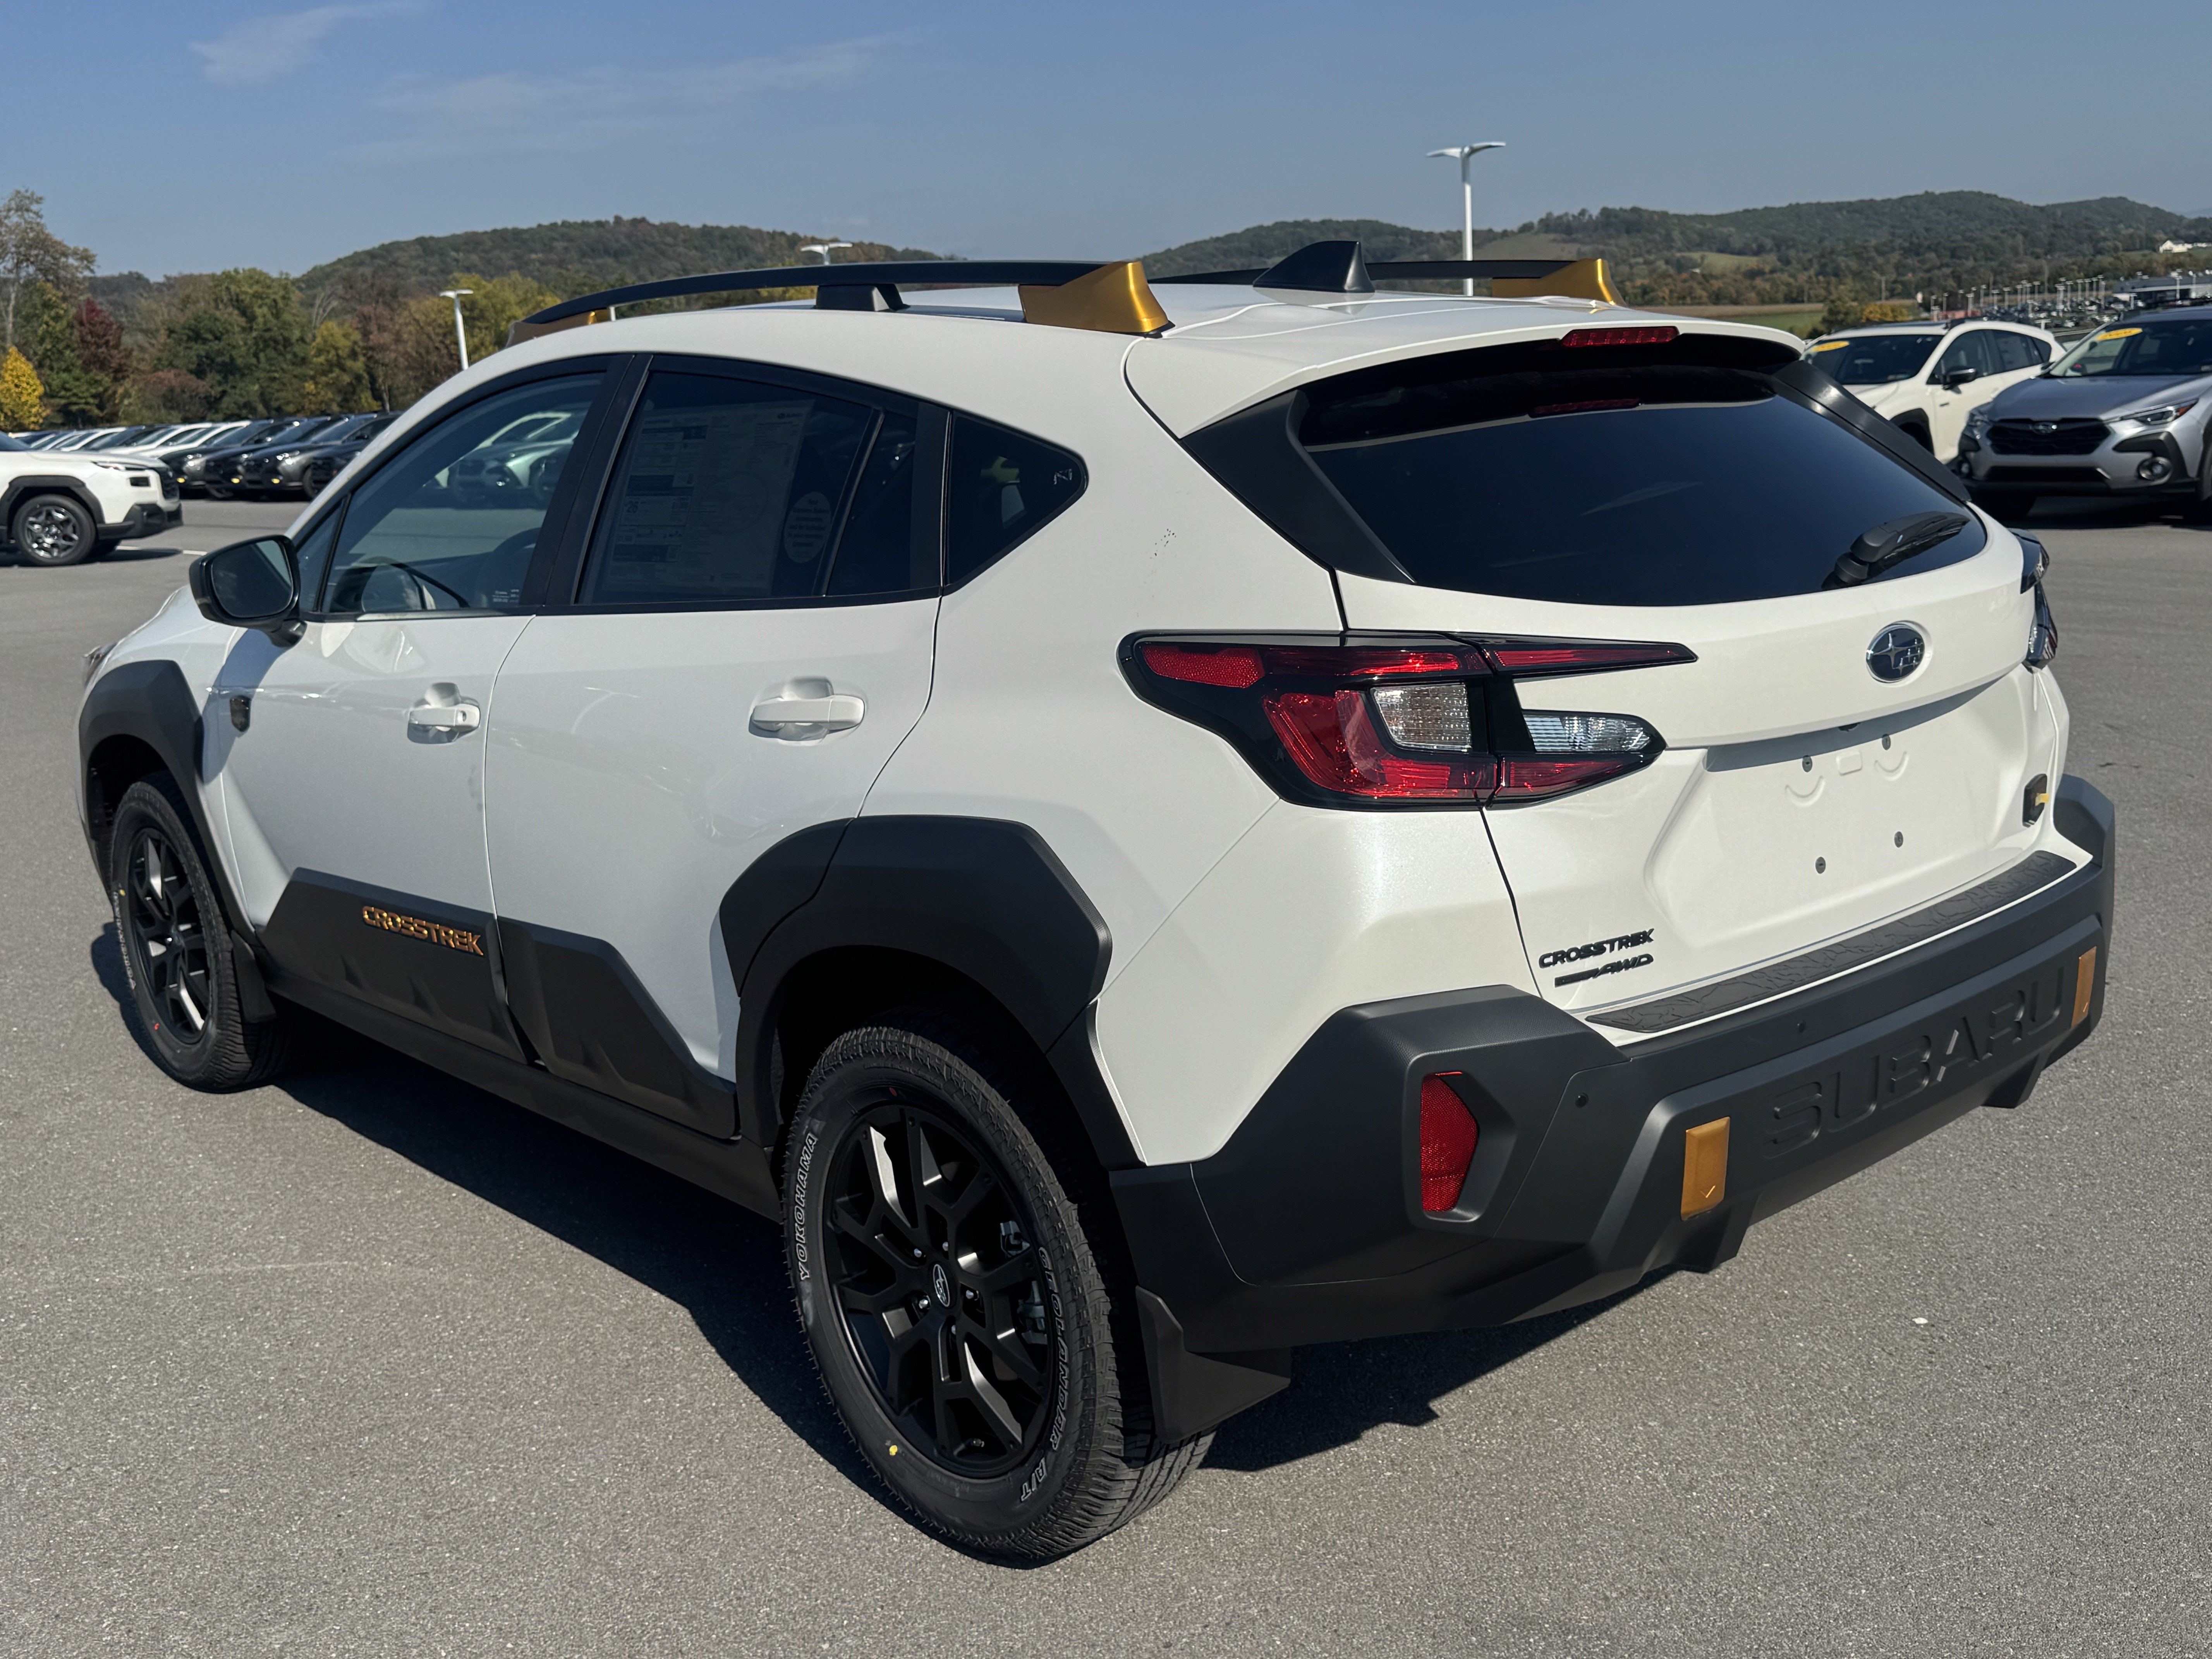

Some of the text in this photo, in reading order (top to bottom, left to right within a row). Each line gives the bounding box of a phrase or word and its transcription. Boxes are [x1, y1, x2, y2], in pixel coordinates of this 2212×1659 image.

[362, 905, 484, 956] CROSSTREK
[1539, 928, 1655, 969] CROSSTREK
[1594, 953, 1654, 979] AWD
[1762, 965, 2065, 1159] SUBARU
[794, 1133, 818, 1280] YOKOHAMA
[1021, 1247, 1070, 1502] GEOLANDAR A/T
